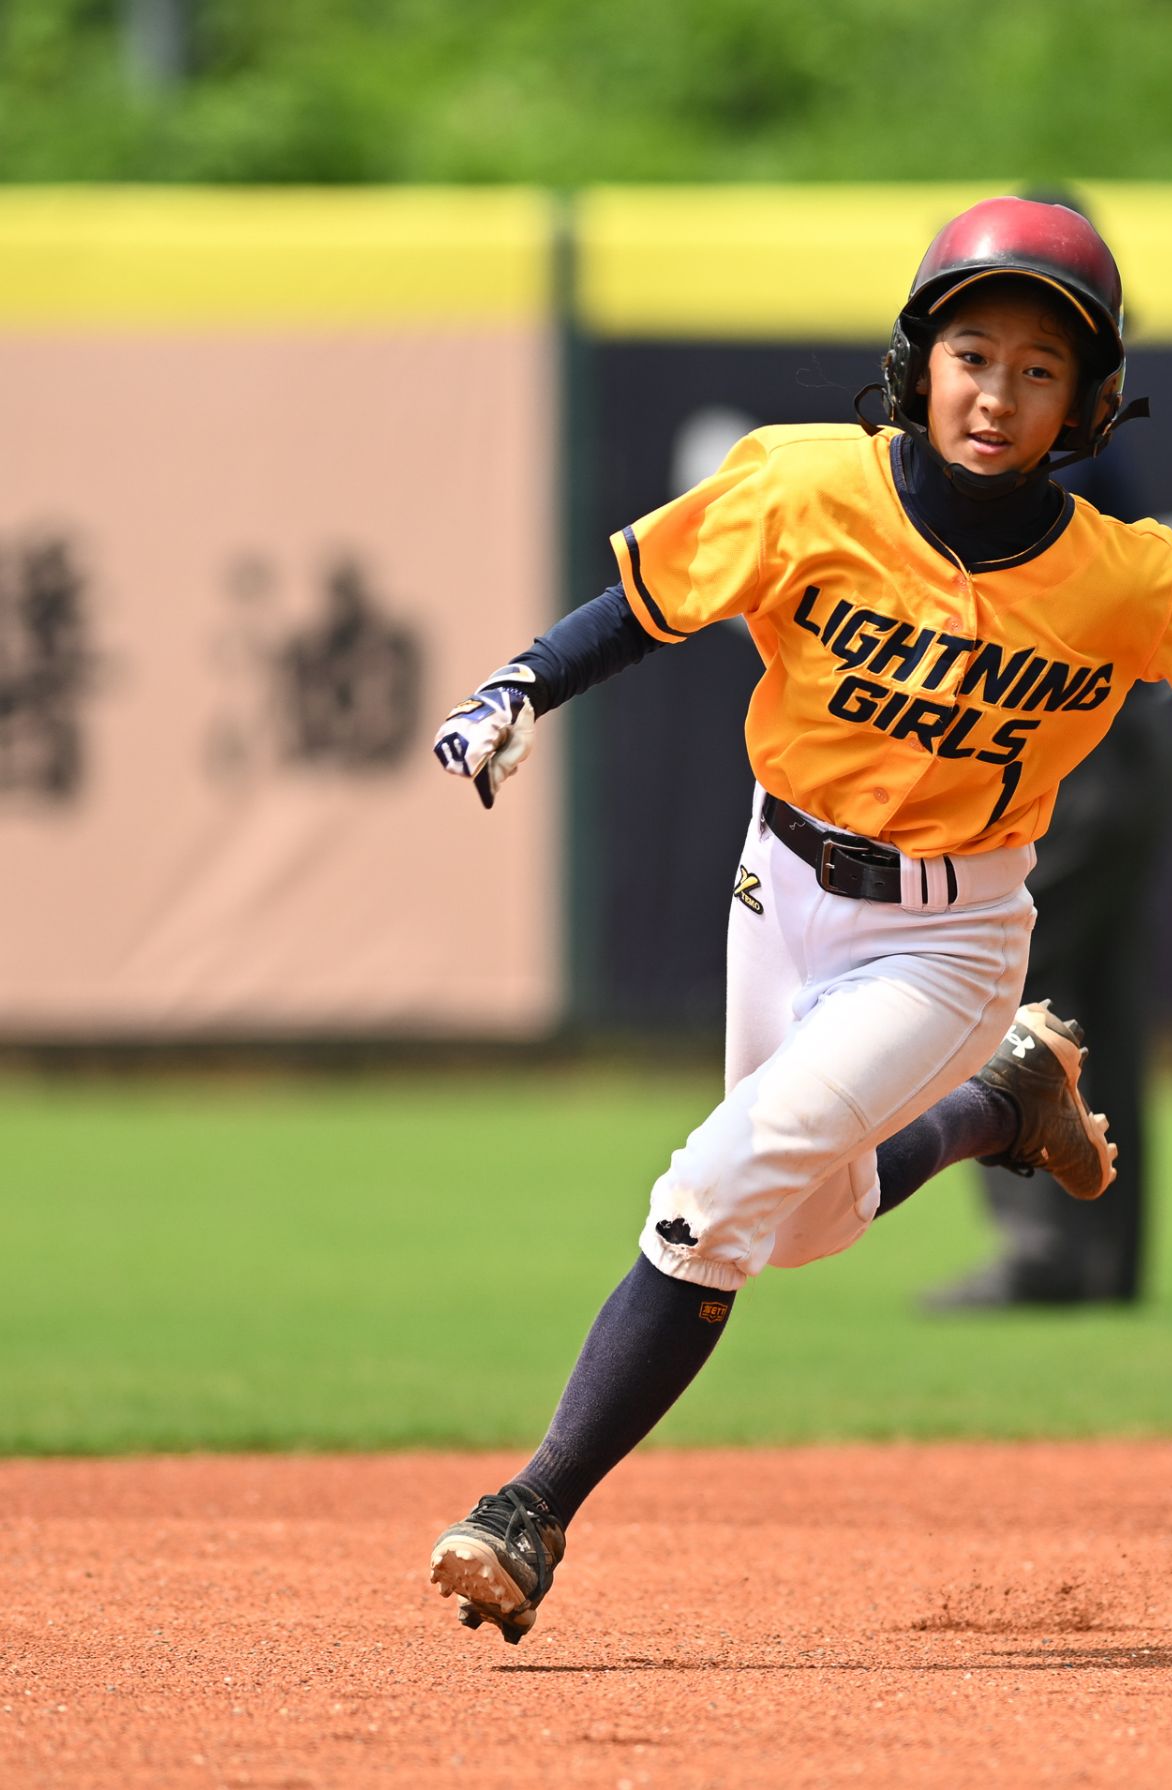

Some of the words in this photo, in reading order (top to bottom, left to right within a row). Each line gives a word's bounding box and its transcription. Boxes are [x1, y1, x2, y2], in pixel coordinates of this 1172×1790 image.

[792, 584, 1114, 713] LIGHTNING
[827, 674, 1042, 765] GIRLS
[982, 760, 1025, 830] 1
